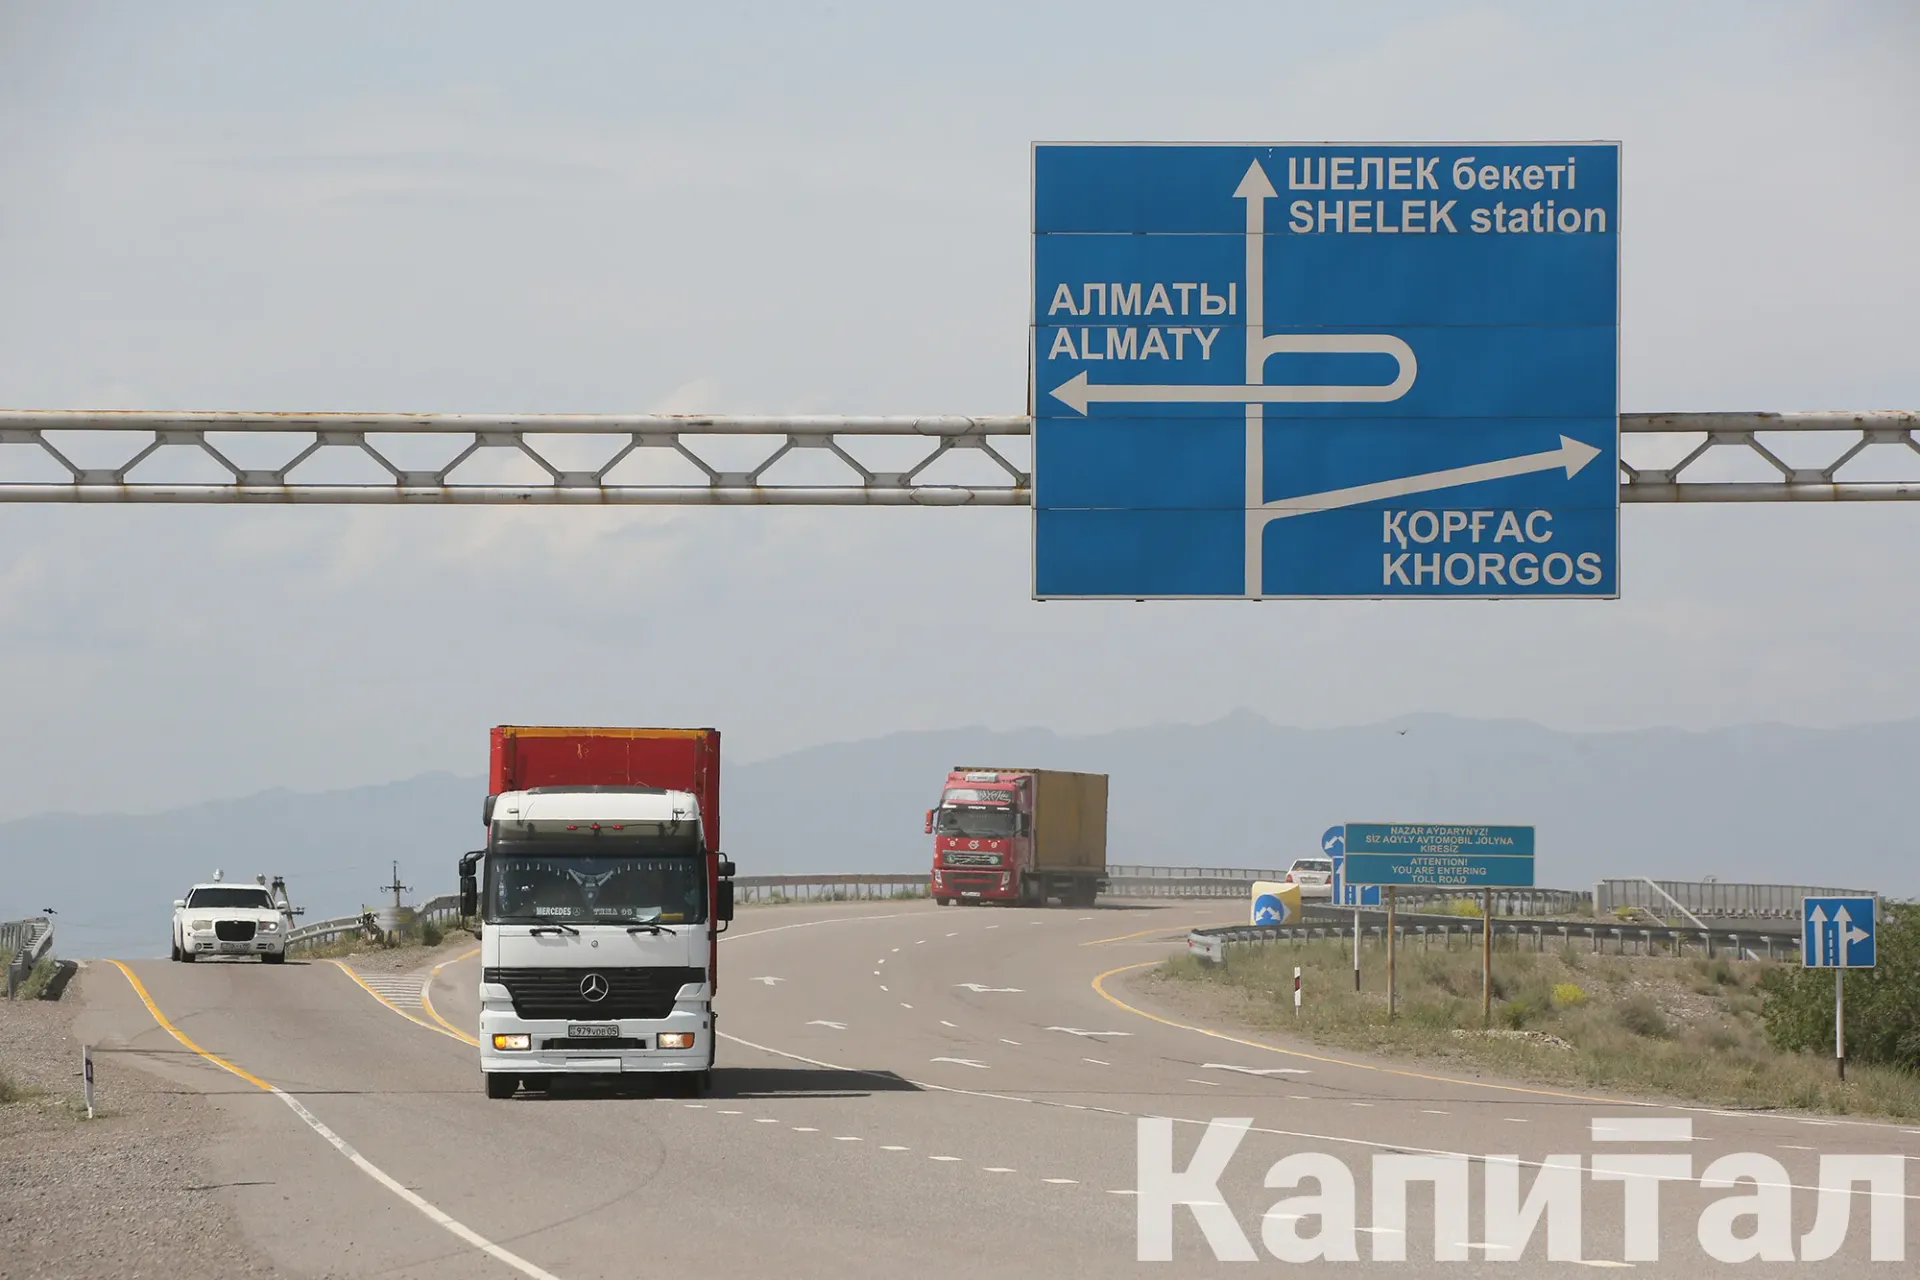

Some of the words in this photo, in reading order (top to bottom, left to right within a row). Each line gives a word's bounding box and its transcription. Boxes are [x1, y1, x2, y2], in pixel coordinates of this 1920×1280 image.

[1289, 158, 1439, 190] ШЕЛЕК
[1453, 157, 1575, 190] бекеті
[1289, 200, 1457, 233] SHELEK
[1471, 200, 1606, 233] station
[1048, 282, 1237, 316] АЛМАТЫ
[1048, 328, 1220, 360] ALMATY
[1384, 510, 1553, 549] ҚОРҒАС
[1383, 553, 1602, 586] KHORGOS
[1475, 837, 1513, 845] JOLYNA
[1392, 866, 1412, 874] YOU
[1415, 867, 1434, 875] ARE
[1438, 867, 1486, 876] ENTERING
[1411, 858, 1467, 866] ATTENTION!
[1412, 875, 1436, 883] TOLL
[1439, 876, 1467, 884] ROAD
[536, 907, 571, 916] MERCEDES
